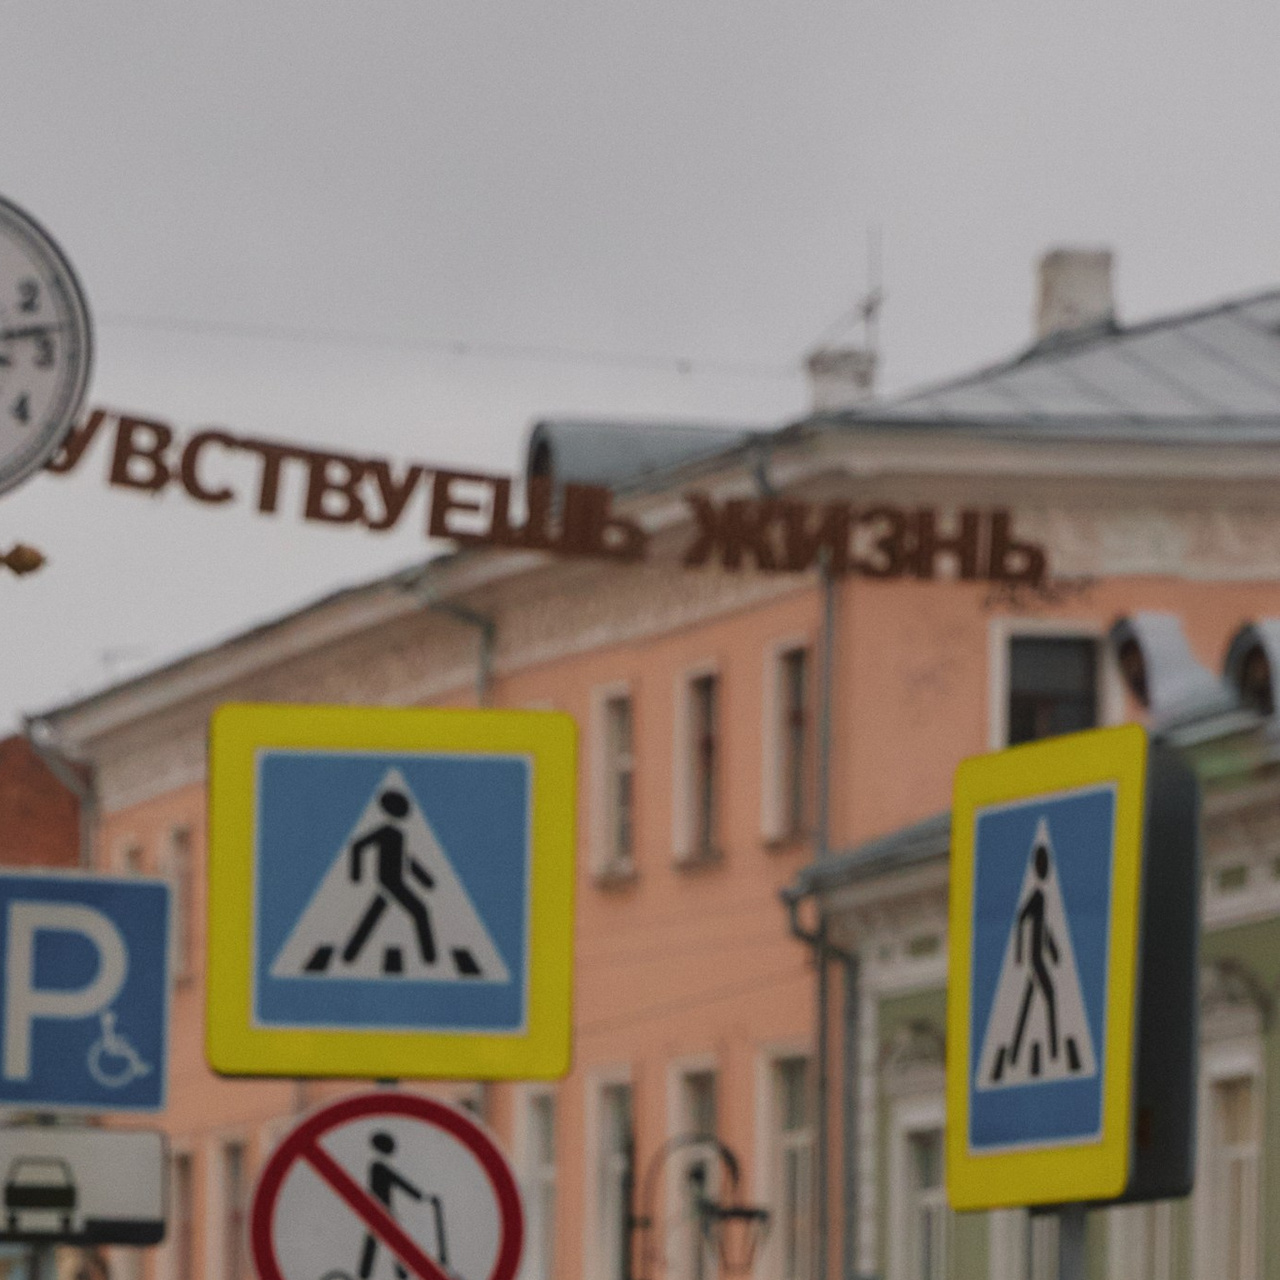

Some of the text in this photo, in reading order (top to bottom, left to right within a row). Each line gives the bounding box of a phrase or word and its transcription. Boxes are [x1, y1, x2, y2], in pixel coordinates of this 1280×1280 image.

[18, 280, 39, 312] 2
[45, 410, 1047, 586] УВСТВУЕШЬ ЖИЗНЬ
[3, 902, 128, 1081] P
